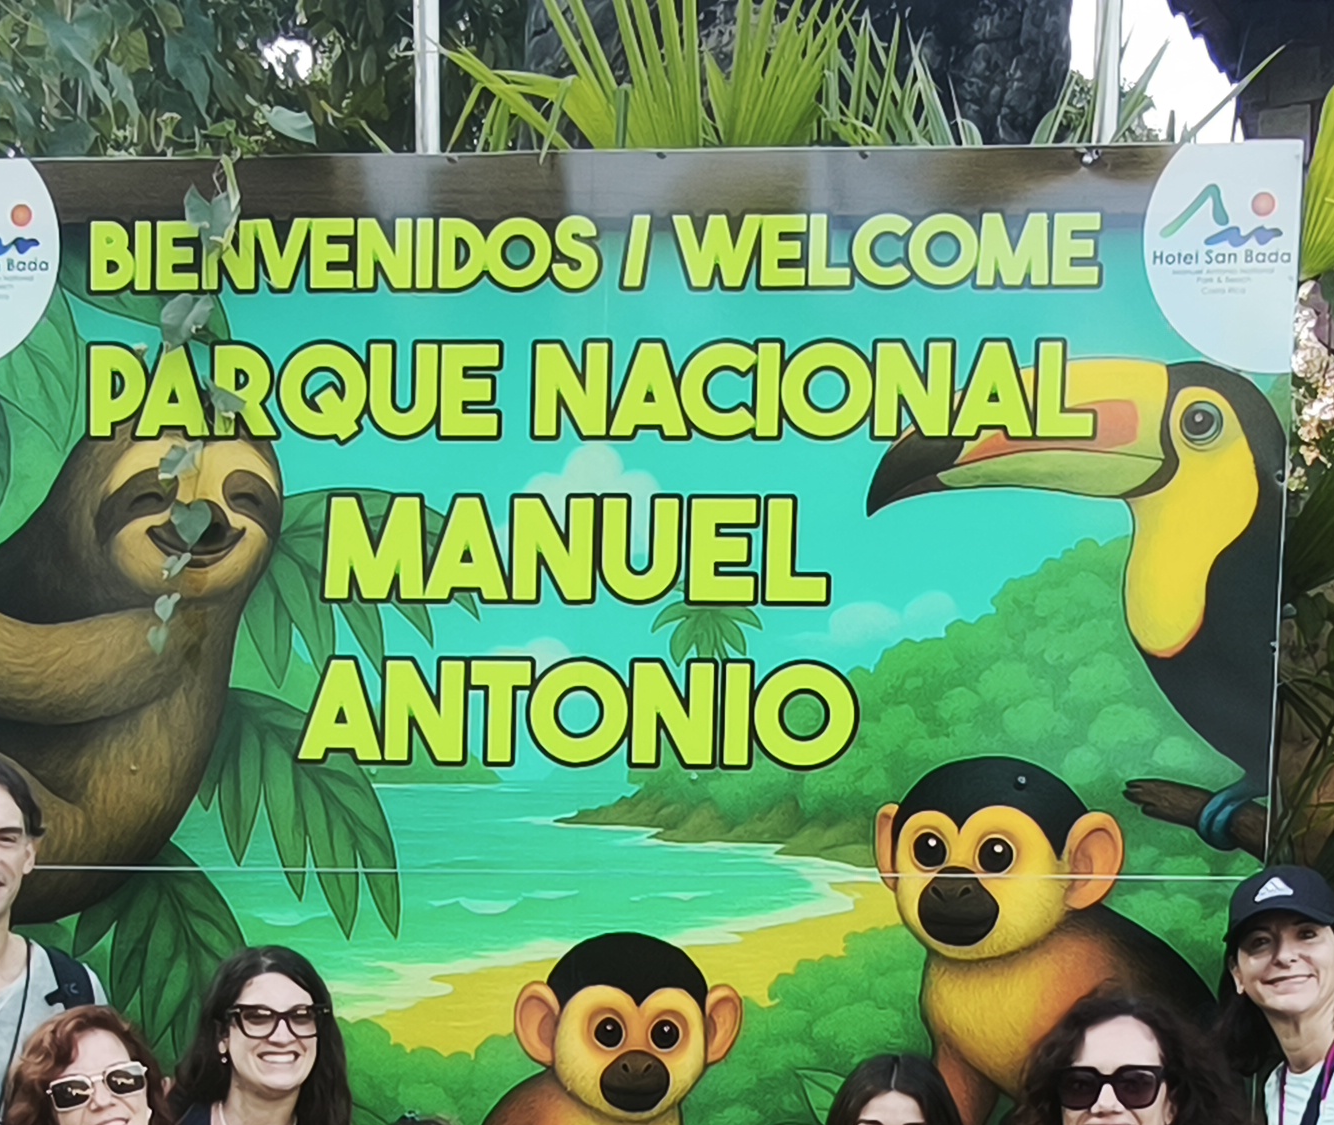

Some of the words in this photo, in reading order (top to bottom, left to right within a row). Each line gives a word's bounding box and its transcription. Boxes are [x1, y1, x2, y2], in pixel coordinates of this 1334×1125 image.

[7, 257, 49, 272] Bada
[89, 215, 601, 291] BIENVENIDOS
[673, 212, 1103, 288] WELCOME
[1152, 250, 1199, 265] Hotel
[1205, 249, 1237, 264] San
[1244, 248, 1291, 263] Bada
[89, 341, 501, 442] PARQUE
[533, 340, 1097, 438] NACIONAL
[324, 495, 829, 604] MANUEL
[298, 658, 857, 767] ANTONIO
